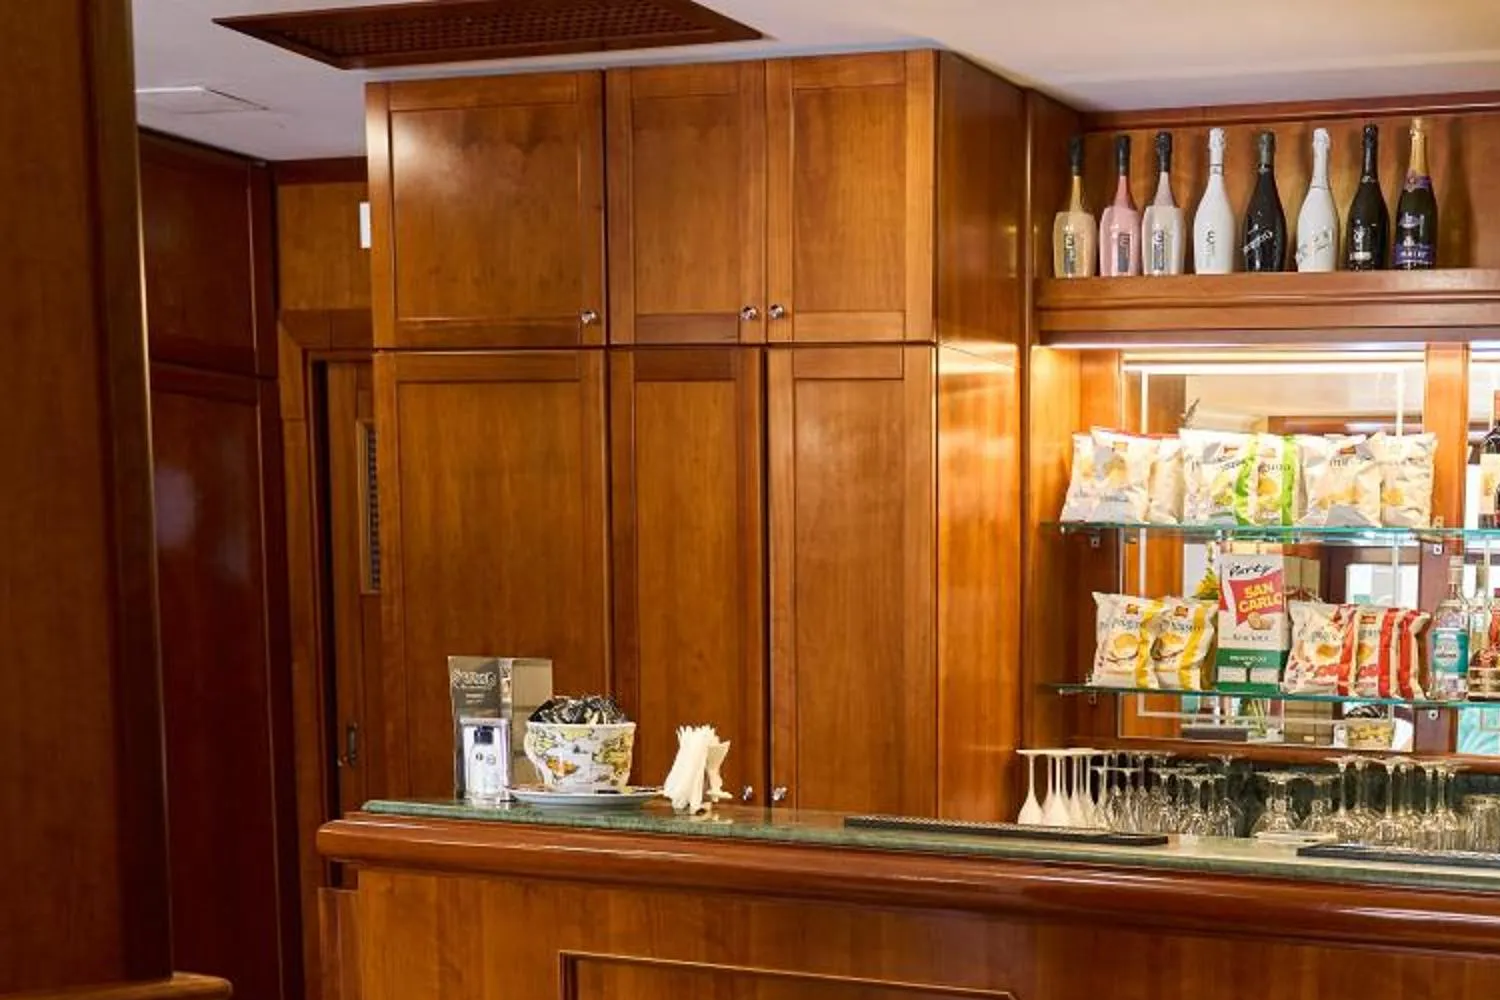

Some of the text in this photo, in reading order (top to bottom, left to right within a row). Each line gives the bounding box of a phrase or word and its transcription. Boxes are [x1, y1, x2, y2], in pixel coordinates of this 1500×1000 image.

[1229, 563, 1273, 578] Party
[1244, 581, 1274, 598] SAN
[1237, 592, 1283, 613] CARLO
